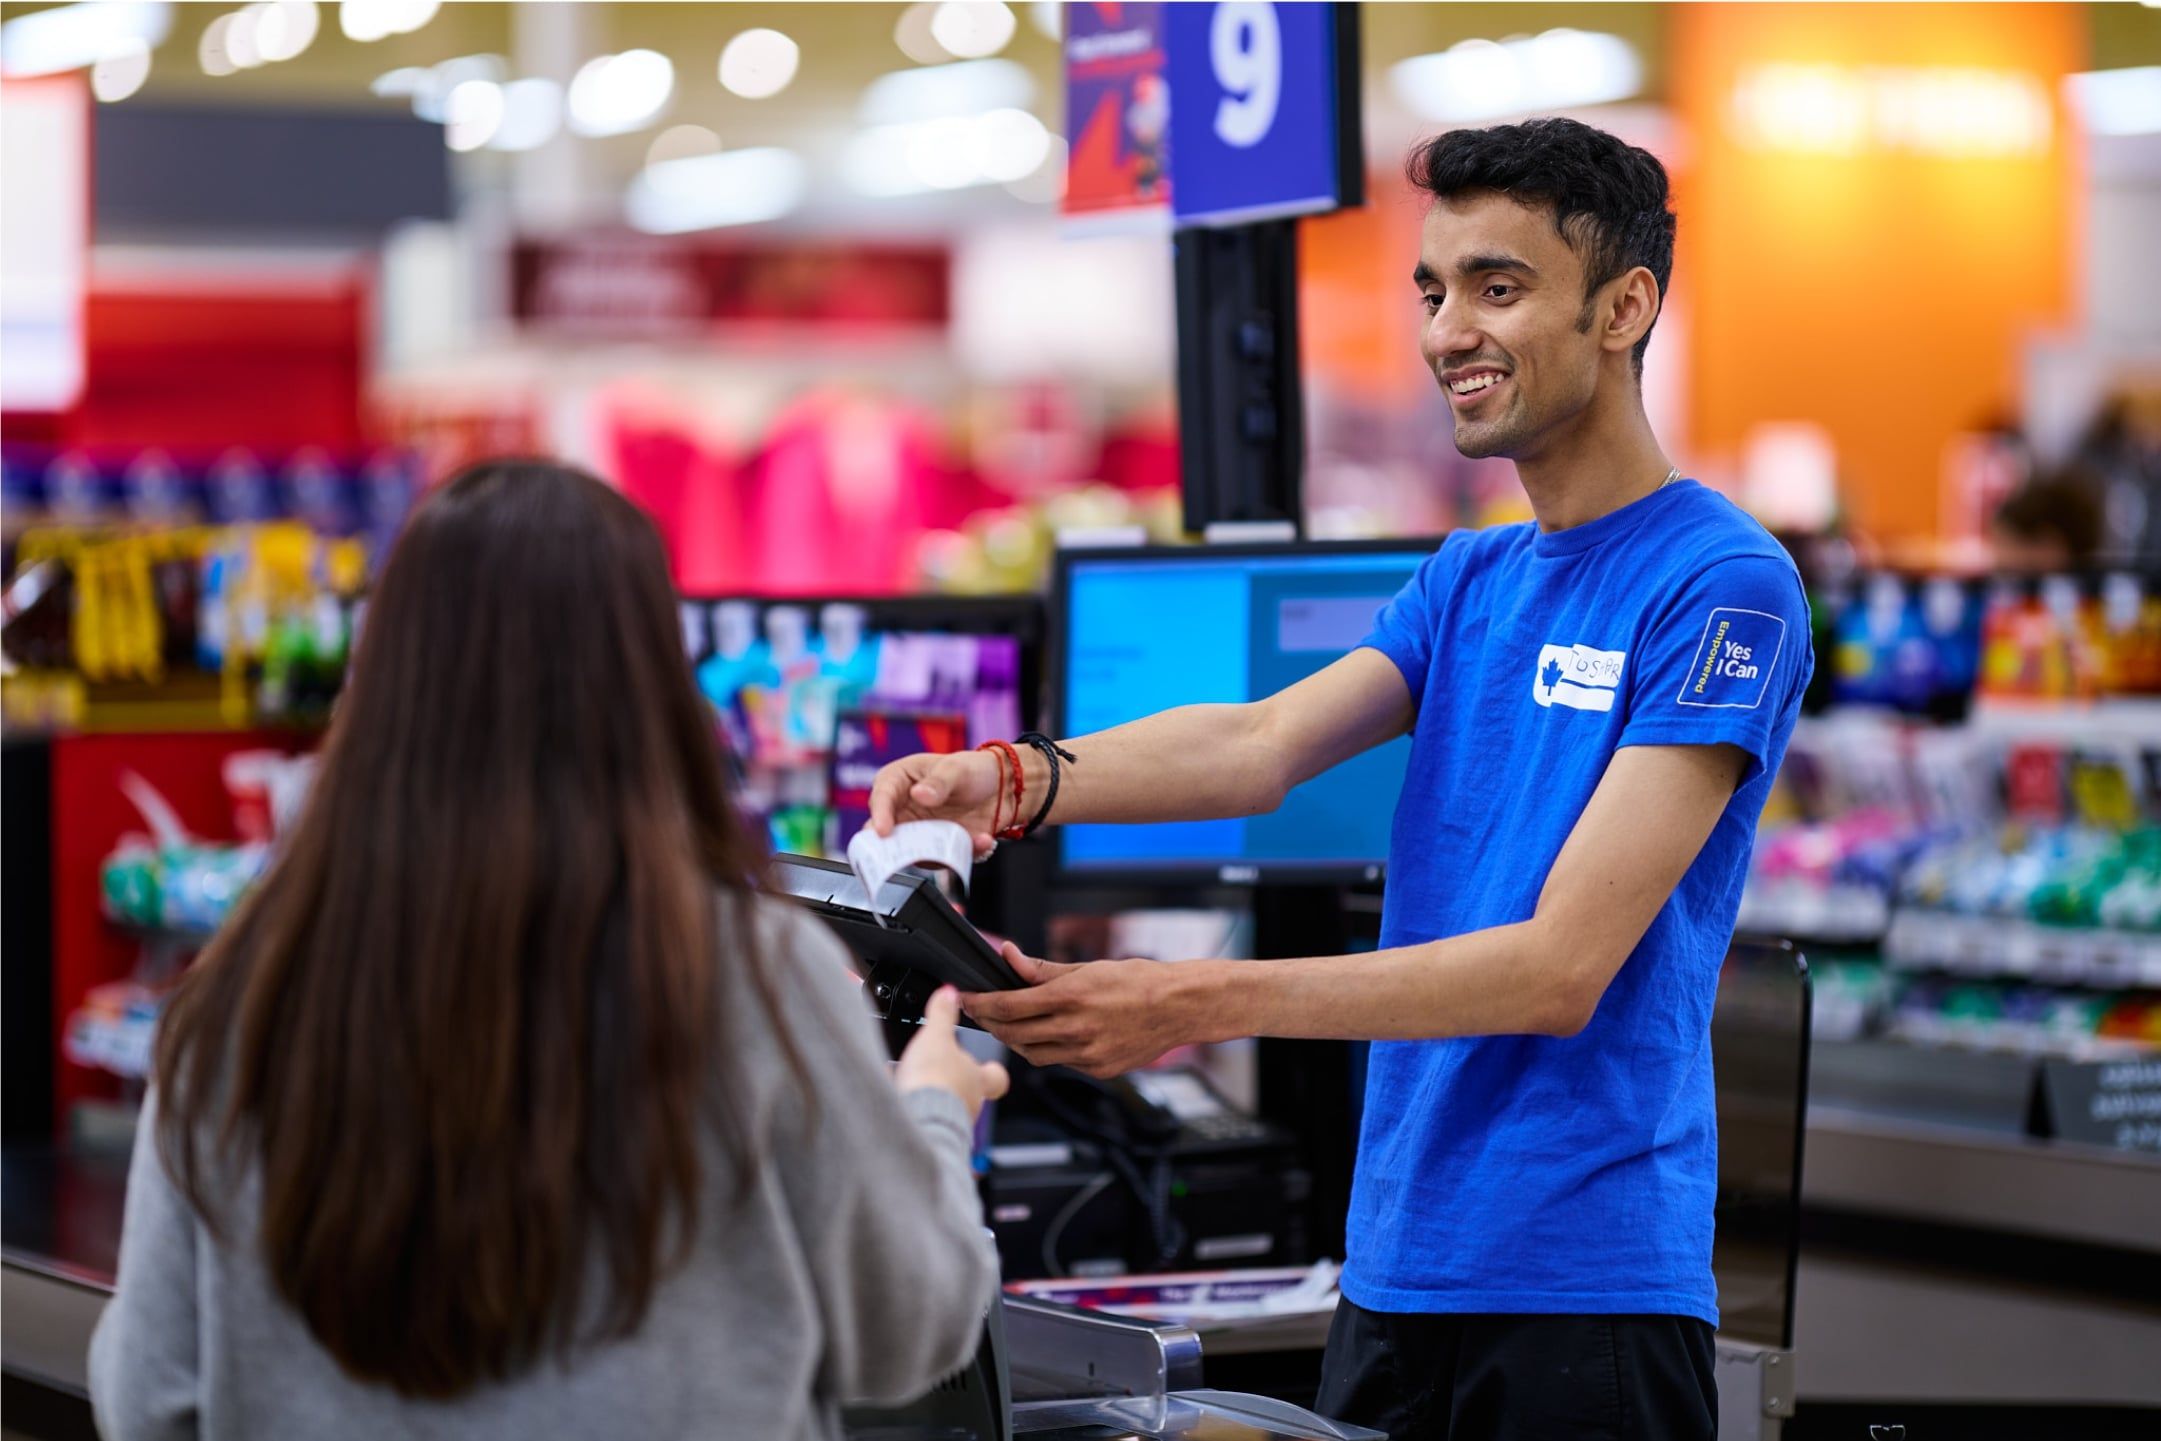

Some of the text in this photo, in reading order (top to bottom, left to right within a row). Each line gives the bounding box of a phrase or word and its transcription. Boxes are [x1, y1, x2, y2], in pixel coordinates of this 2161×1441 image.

[1210, 1, 1282, 147] 9
[1694, 621, 1730, 693] Empowered
[1715, 659, 1758, 679] I Can
[1725, 640, 1752, 661] Yes
